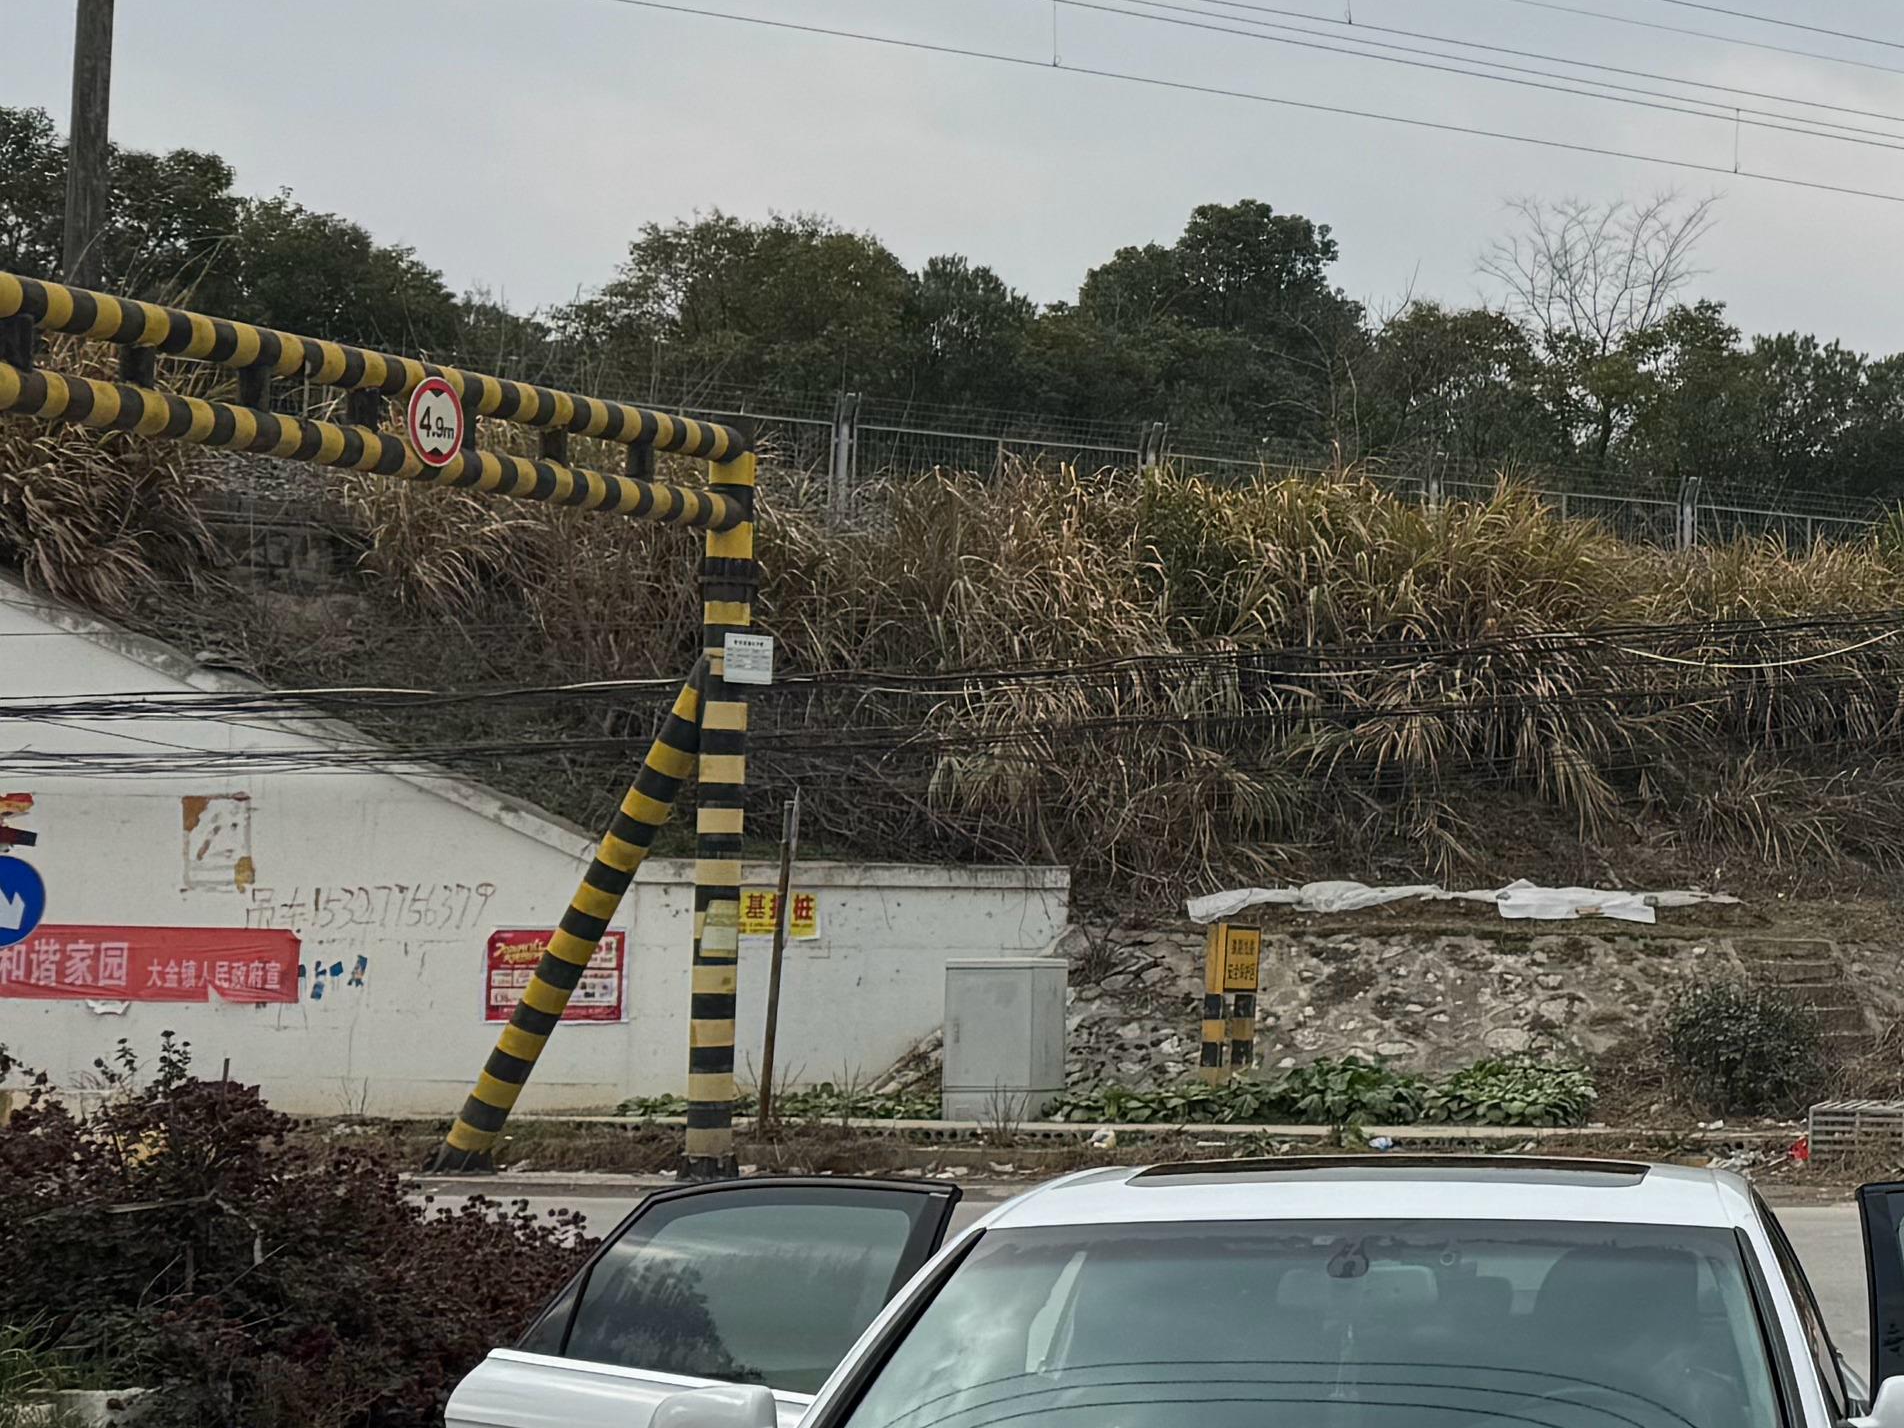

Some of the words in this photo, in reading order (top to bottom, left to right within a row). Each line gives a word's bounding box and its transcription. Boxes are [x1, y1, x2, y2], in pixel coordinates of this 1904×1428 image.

[419, 406, 455, 440] 4.9m
[0, 938, 128, 988] 和谐家园
[147, 958, 282, 990] 大金镇人民政府宣
